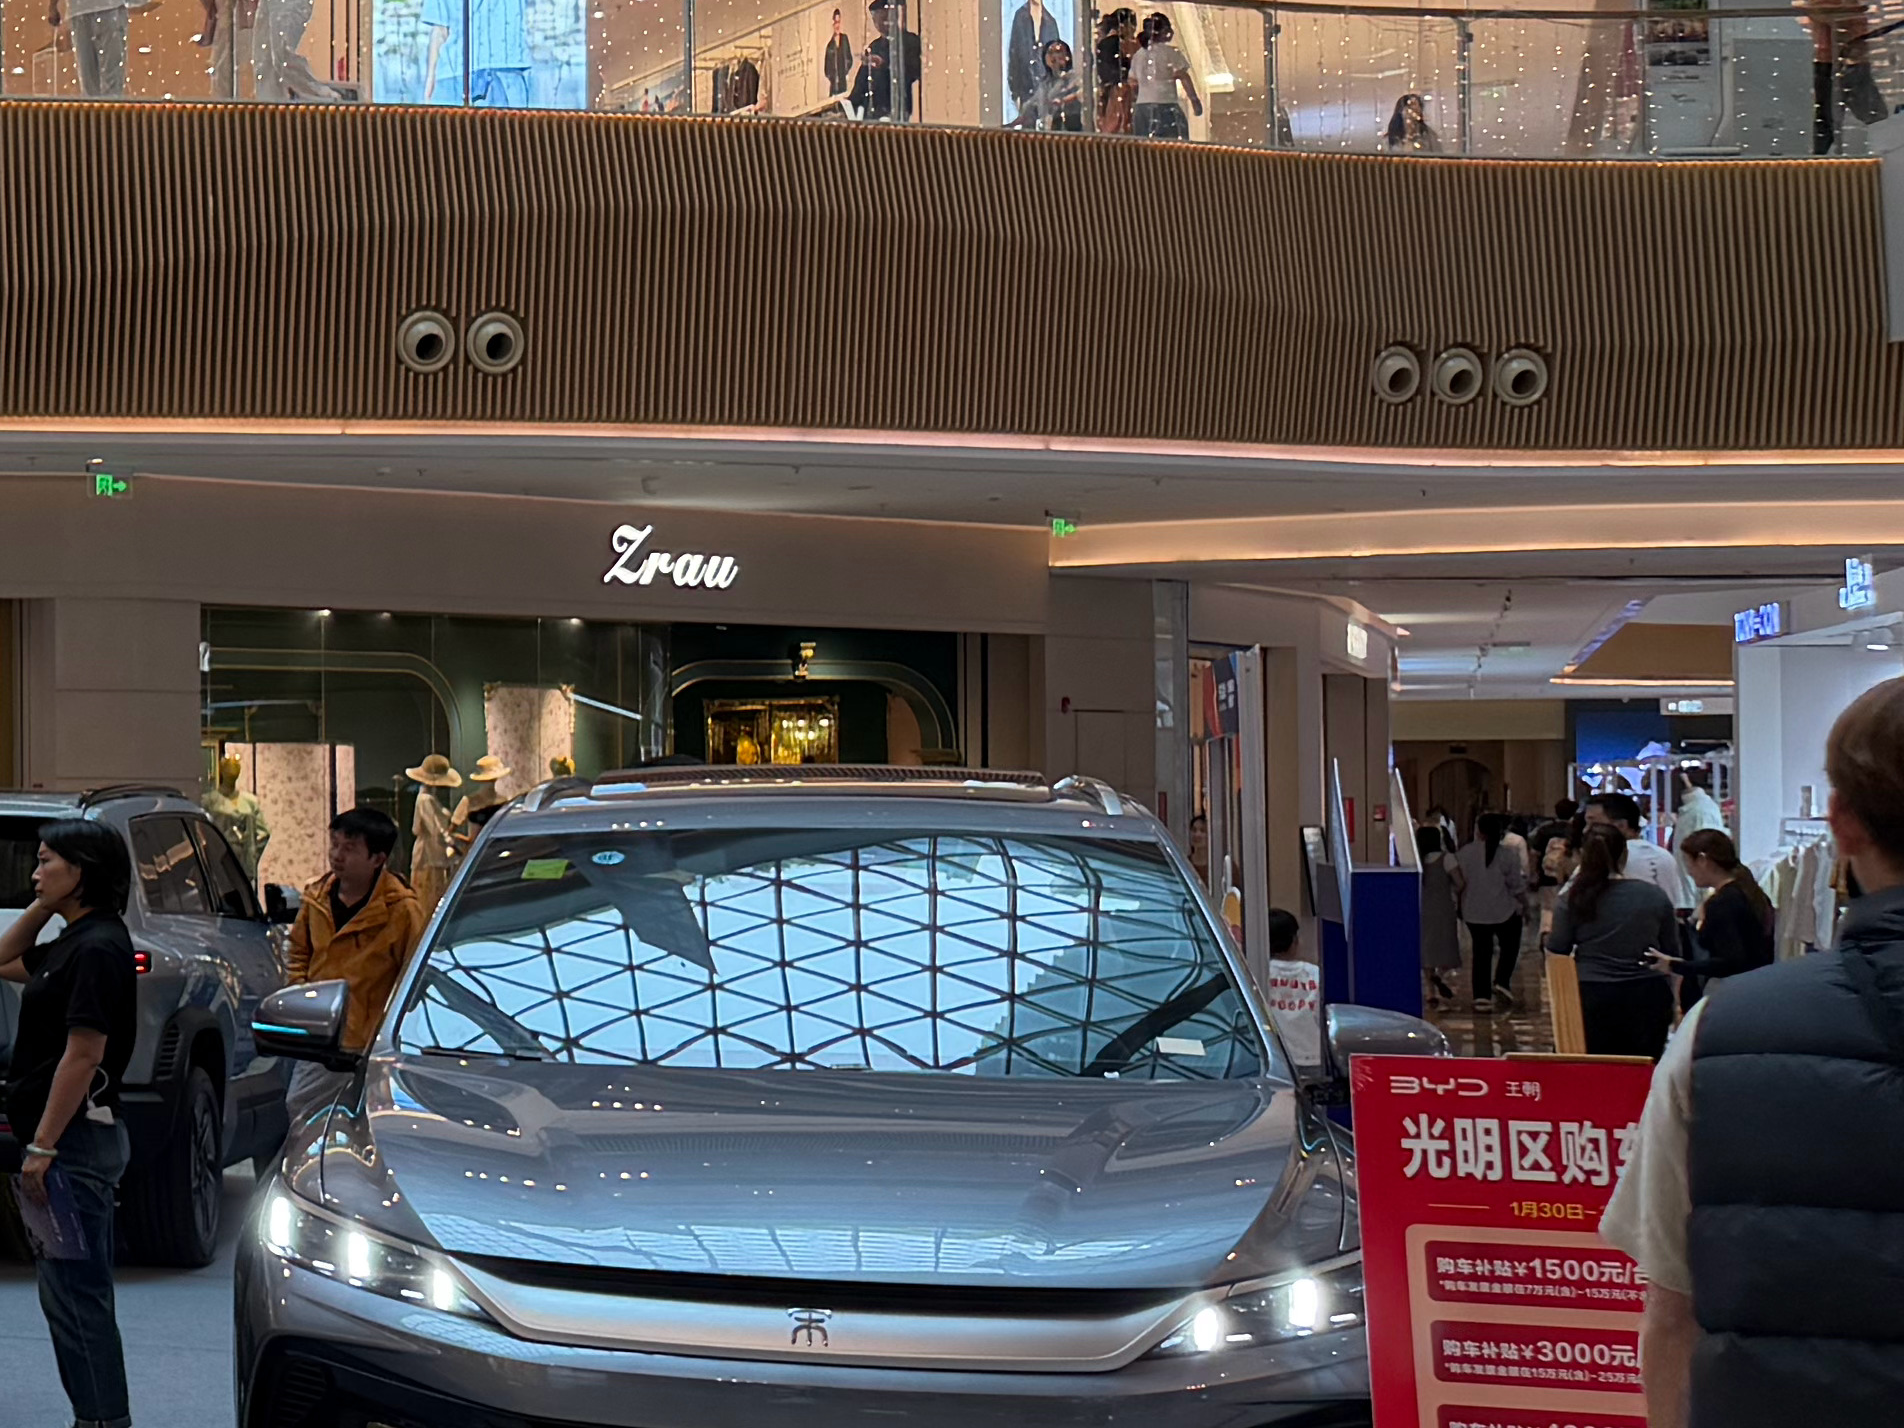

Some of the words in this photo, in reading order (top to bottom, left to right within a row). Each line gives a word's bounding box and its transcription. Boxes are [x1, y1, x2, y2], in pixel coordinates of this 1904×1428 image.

[603, 523, 739, 590] Zrau
[1389, 1075, 1489, 1097] BYD
[1505, 1080, 1542, 1101] 王朝
[1510, 1201, 1603, 1220] 1月30日-
